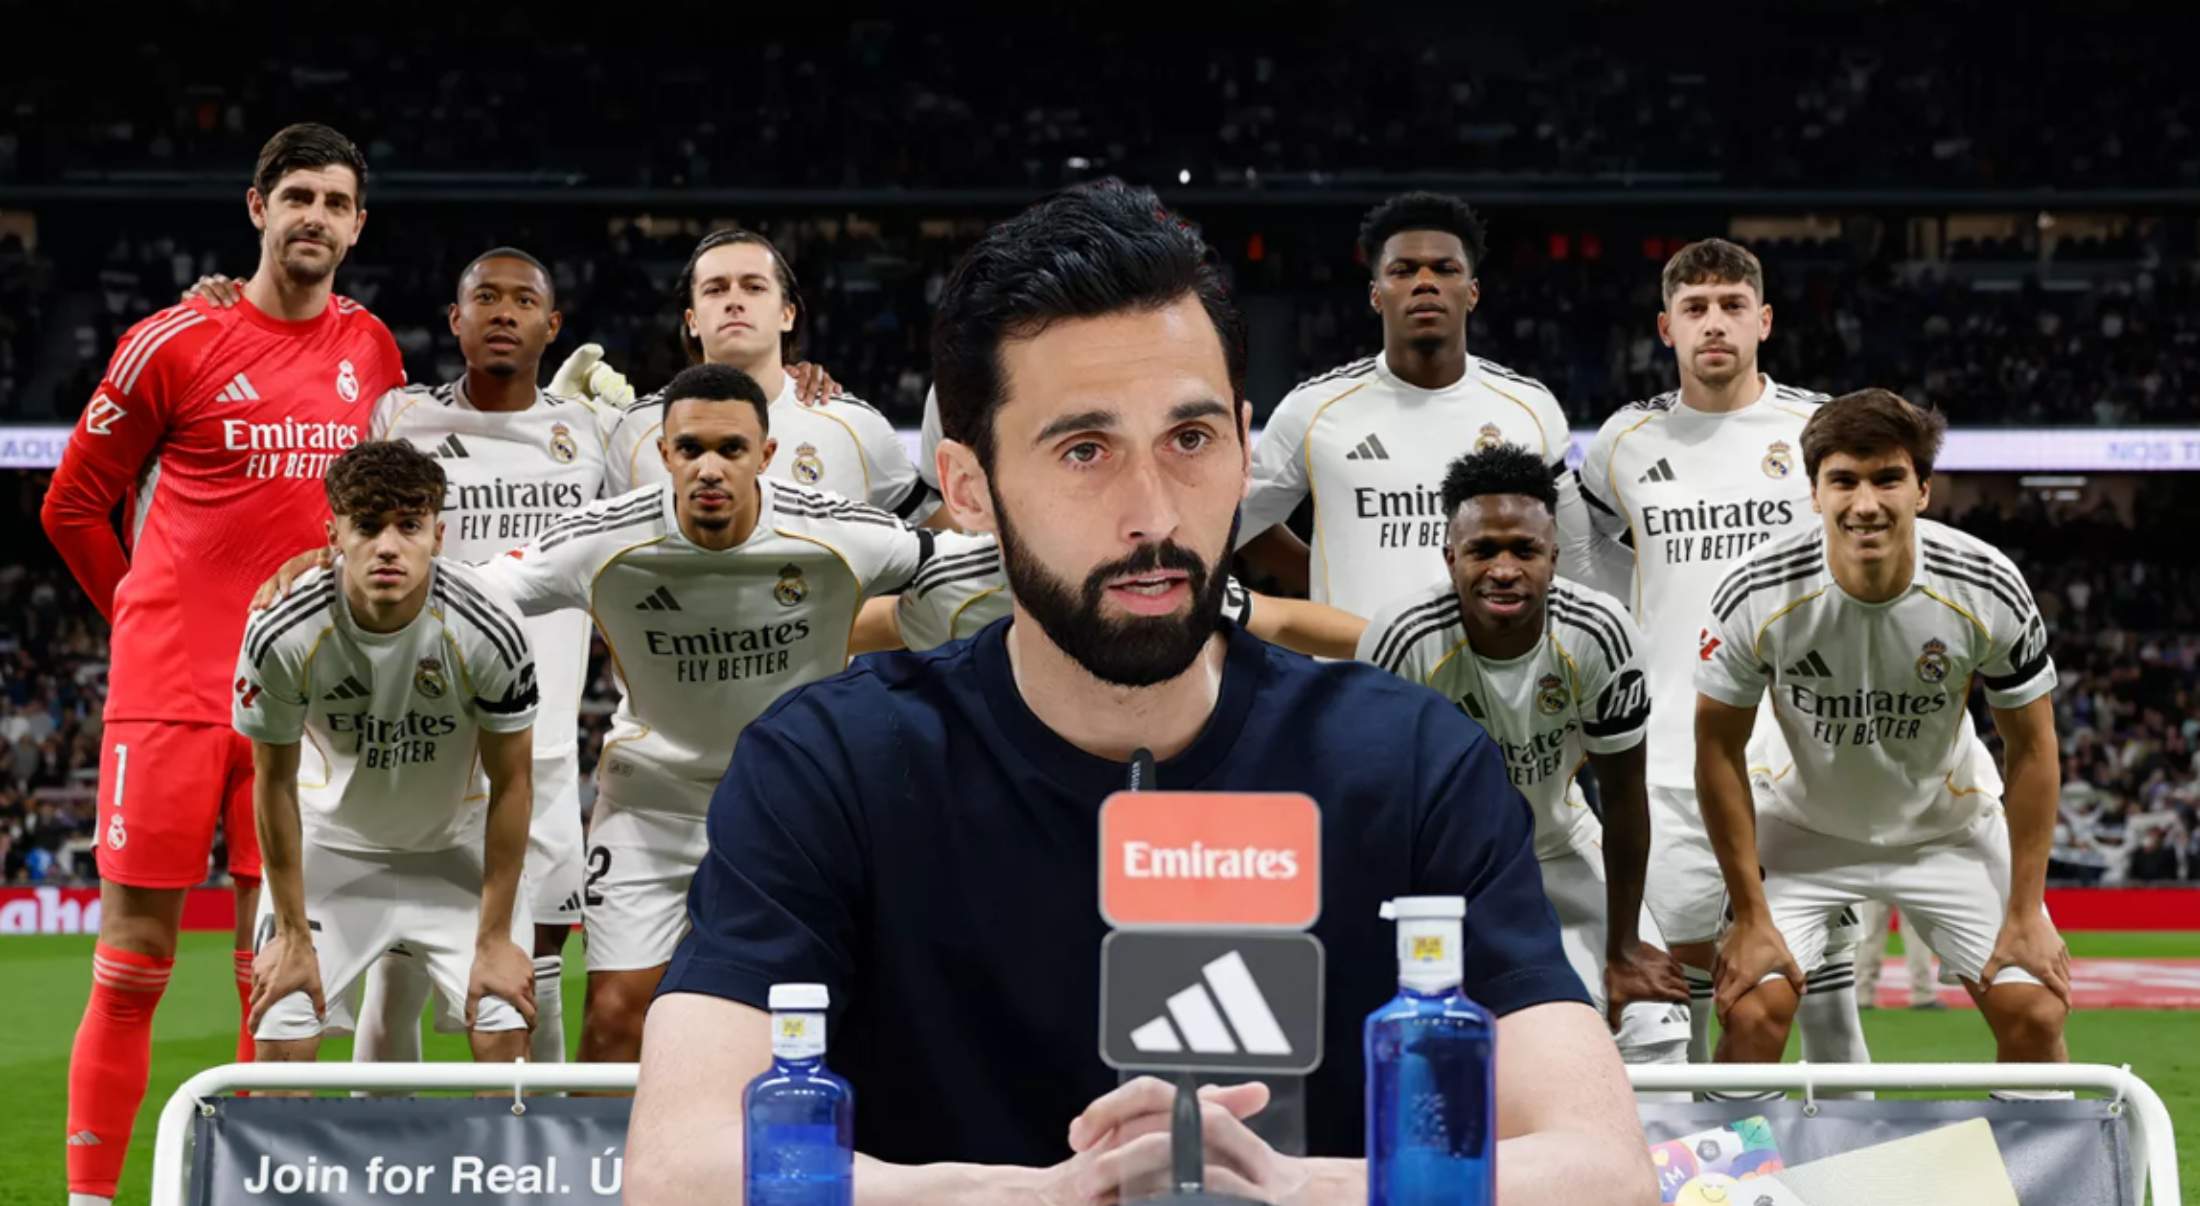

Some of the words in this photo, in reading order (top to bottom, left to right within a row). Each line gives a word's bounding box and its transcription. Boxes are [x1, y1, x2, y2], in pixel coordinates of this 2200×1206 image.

[222, 415, 359, 450] Emirates
[245, 453, 280, 479] FLY
[283, 452, 340, 479] BETTE
[1354, 483, 1442, 519] Emir
[1641, 497, 1794, 537] Emirates
[460, 514, 492, 540] FLY
[498, 513, 563, 539] BETTE
[1380, 522, 1411, 548] FLY
[1418, 521, 1450, 547] BET
[1665, 537, 1694, 565] FLY
[644, 618, 811, 656] Emirates
[677, 659, 709, 683] FLY
[718, 649, 789, 682] BETTER
[1603, 675, 1642, 720] hp
[1792, 684, 1946, 719] Emirates
[1813, 719, 1847, 747] FLY
[1852, 715, 1921, 746] BETTER
[366, 740, 437, 770] BETTER
[114, 743, 128, 807] 1
[1122, 840, 1299, 880] Emirates
[243, 1155, 350, 1194] Join
[365, 1156, 435, 1193] for
[451, 1156, 571, 1194] Real.
